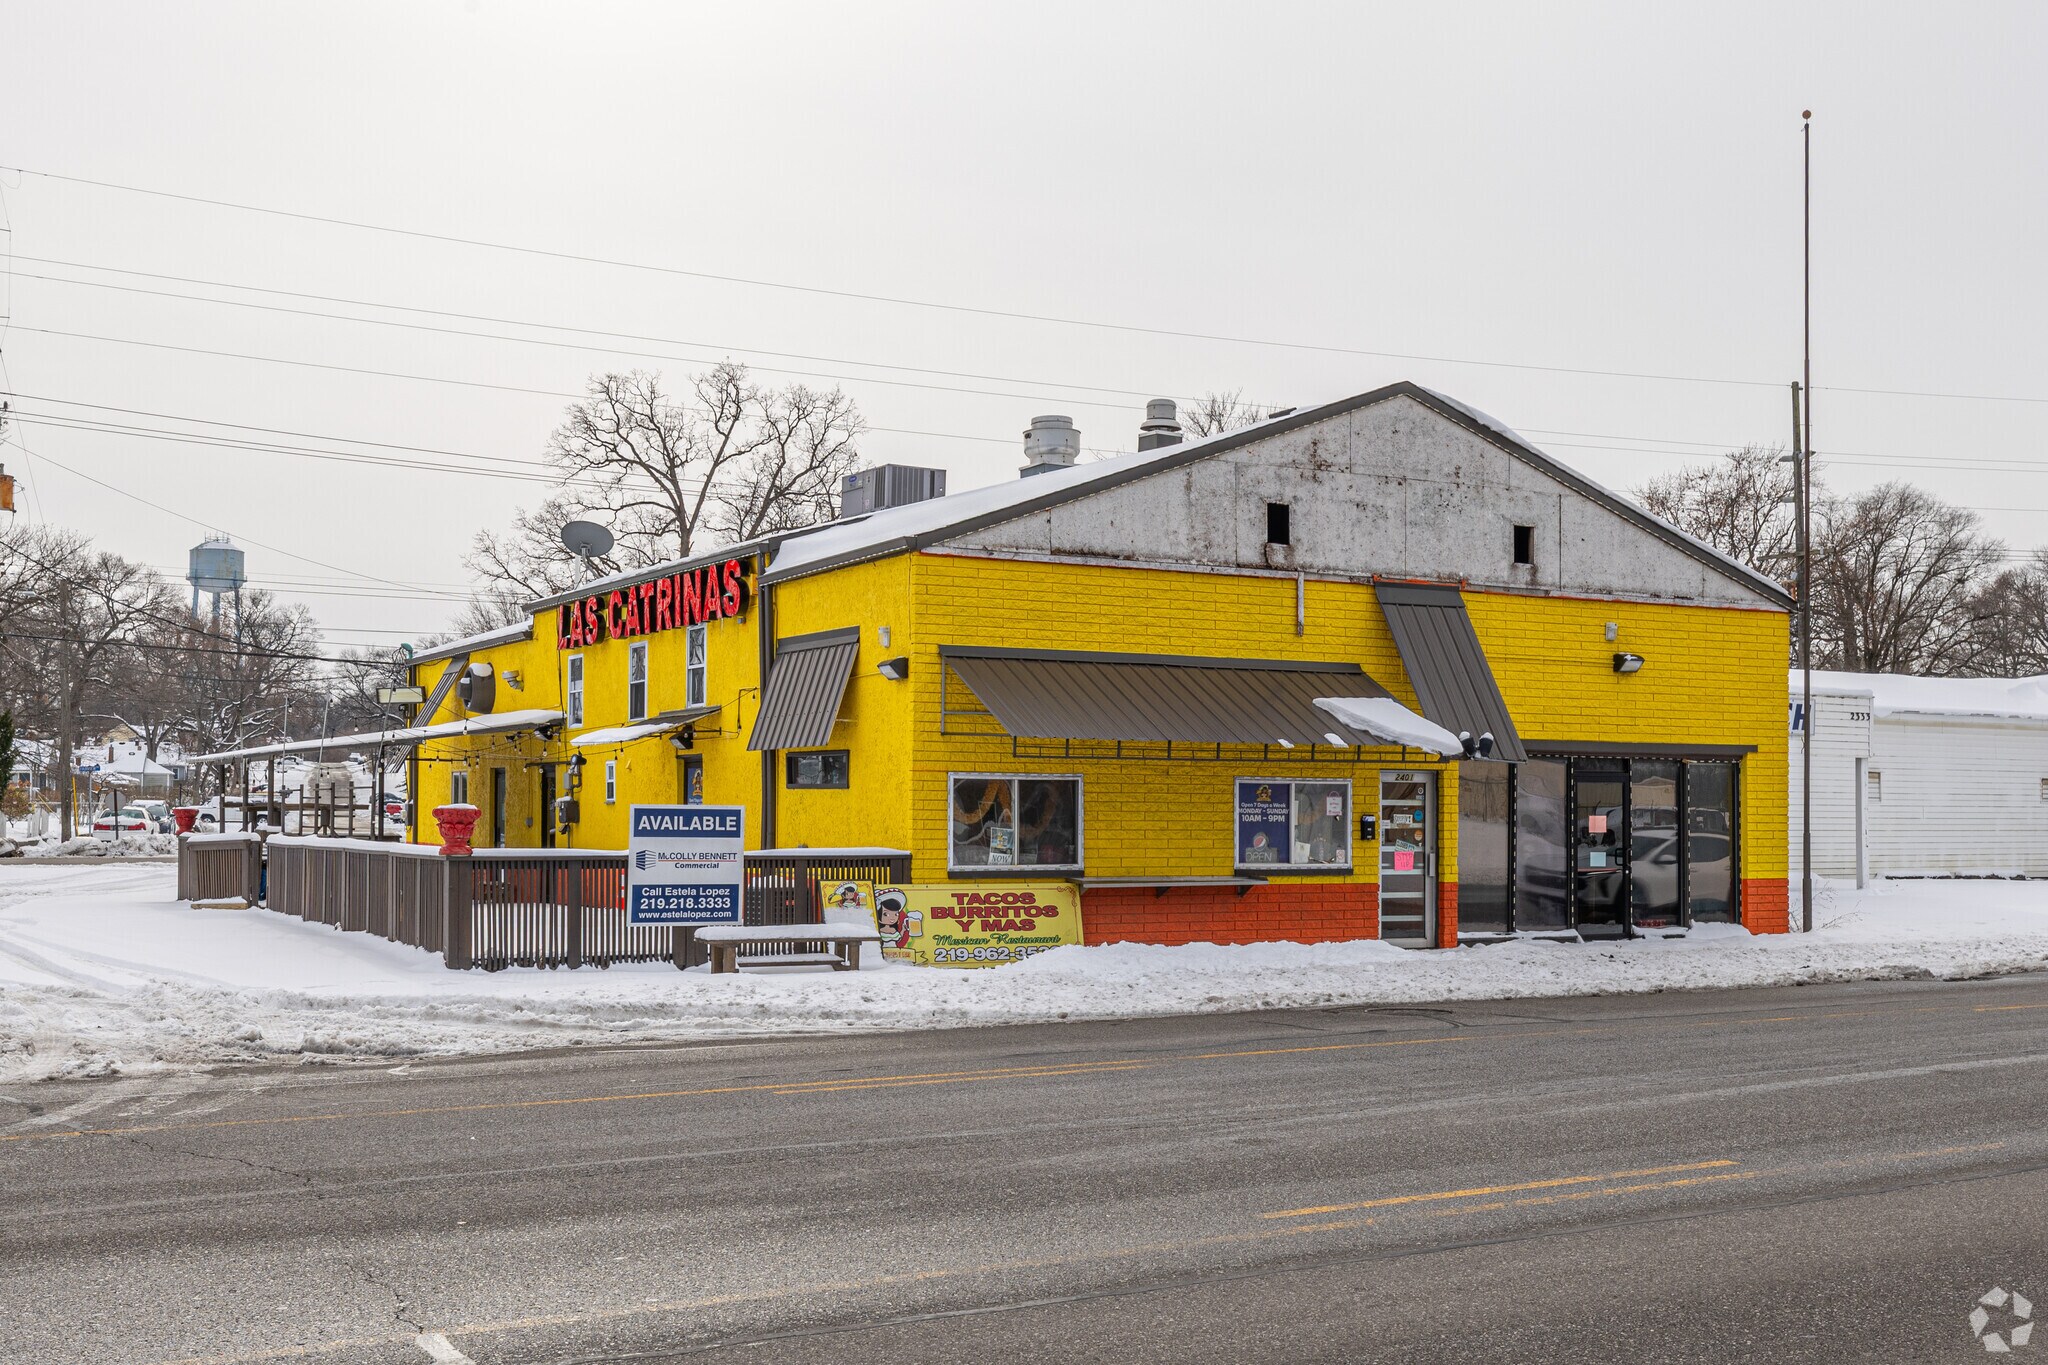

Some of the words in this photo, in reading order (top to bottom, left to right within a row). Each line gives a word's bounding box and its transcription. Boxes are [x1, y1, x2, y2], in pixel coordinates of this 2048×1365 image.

[558, 595, 600, 650] LAS
[608, 559, 743, 640] CATRINAS
[1850, 712, 1870, 721] 2333
[1395, 773, 1414, 781] 2401
[638, 816, 737, 831] AVAILABLE
[658, 852, 697, 860] McCOLLY
[699, 852, 738, 860] BENNETT
[992, 854, 1010, 863] NOW
[1245, 851, 1272, 862] OPEN
[642, 887, 662, 896] Call
[665, 887, 697, 896] Estela
[700, 887, 730, 898] Lopez
[640, 898, 731, 909] 219.218.3333
[950, 892, 1036, 906] TACOS
[638, 911, 732, 920] www.estelalopez.com
[930, 905, 1059, 920] BURRITOS
[955, 919, 974, 933] Y
[981, 918, 1037, 932] MAS
[933, 934, 990, 946] Mexican
[989, 932, 1061, 945] Restaurant
[934, 945, 1060, 963] 219-962-35
